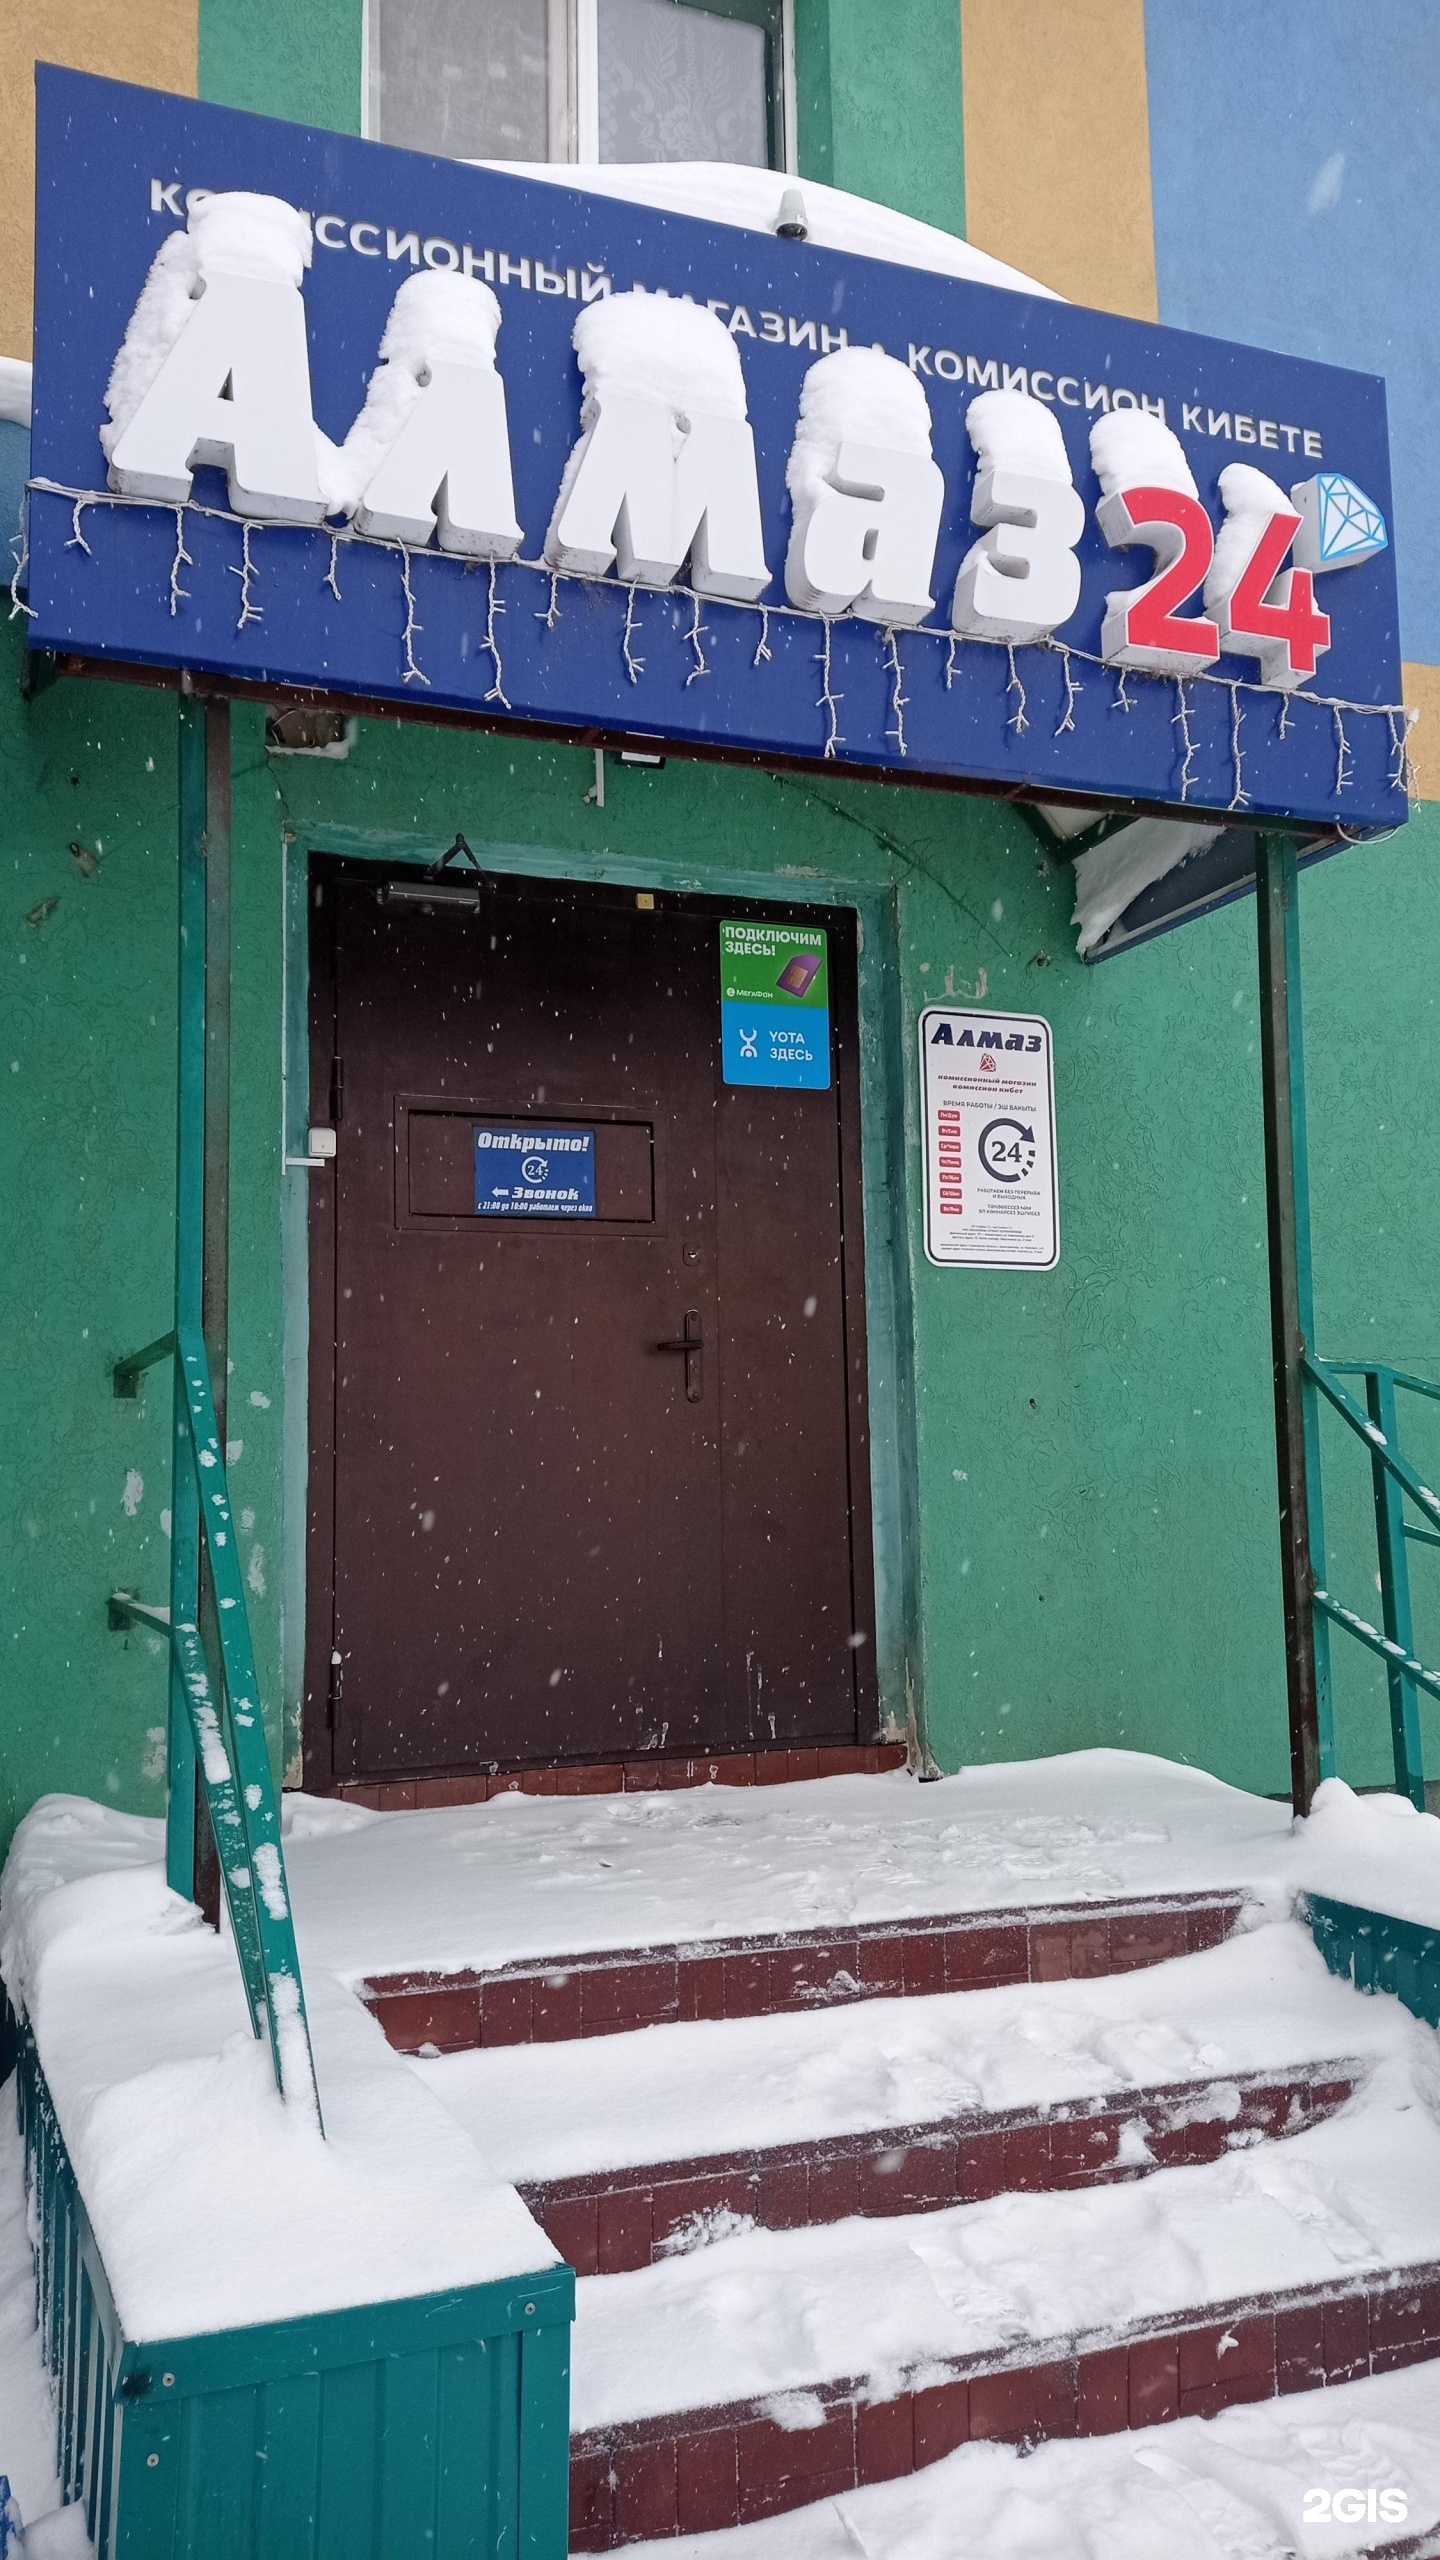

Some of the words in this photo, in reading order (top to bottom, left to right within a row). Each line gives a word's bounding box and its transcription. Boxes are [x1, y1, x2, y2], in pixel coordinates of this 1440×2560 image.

[632, 281, 849, 353] ГАЗИН
[907, 342, 1166, 424] КОМИССИОН
[1182, 402, 1323, 459] КИБЕТЕ
[725, 926, 822, 946] ПОДКЛЮЧИМ
[725, 941, 776, 956] ЗДЕСЬ!
[770, 1048, 813, 1061] ЗДЕСЬ
[943, 1100, 966, 1108] ВРЕМЯ
[966, 1102, 993, 1110] РАБОТЫ
[477, 1132, 590, 1153] Открыто!
[991, 1141, 1022, 1163] 24
[527, 1165, 543, 1176] 24
[511, 1186, 579, 1200] Звонок
